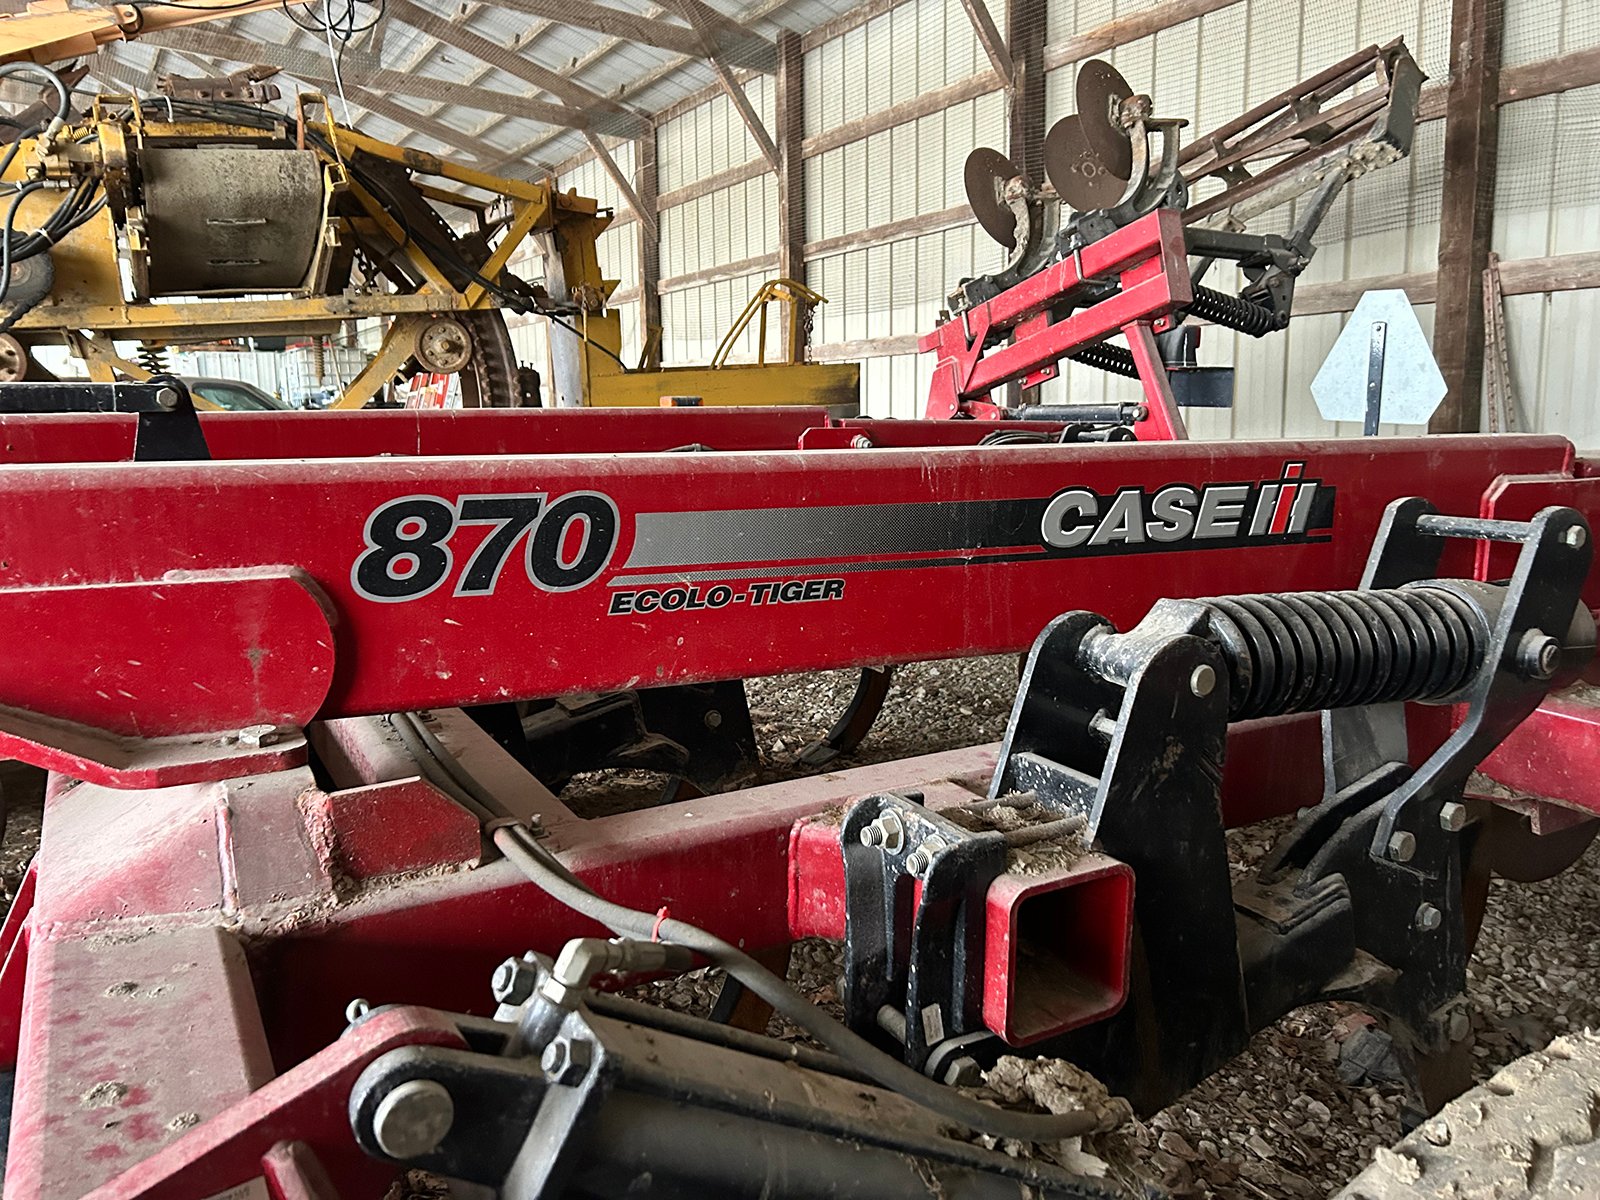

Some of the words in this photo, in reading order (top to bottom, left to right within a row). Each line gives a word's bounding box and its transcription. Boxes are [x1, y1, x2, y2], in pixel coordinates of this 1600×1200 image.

[351, 490, 620, 602] 870
[1041, 486, 1250, 548] CASE
[607, 579, 845, 616] ECOLO-TIGER
